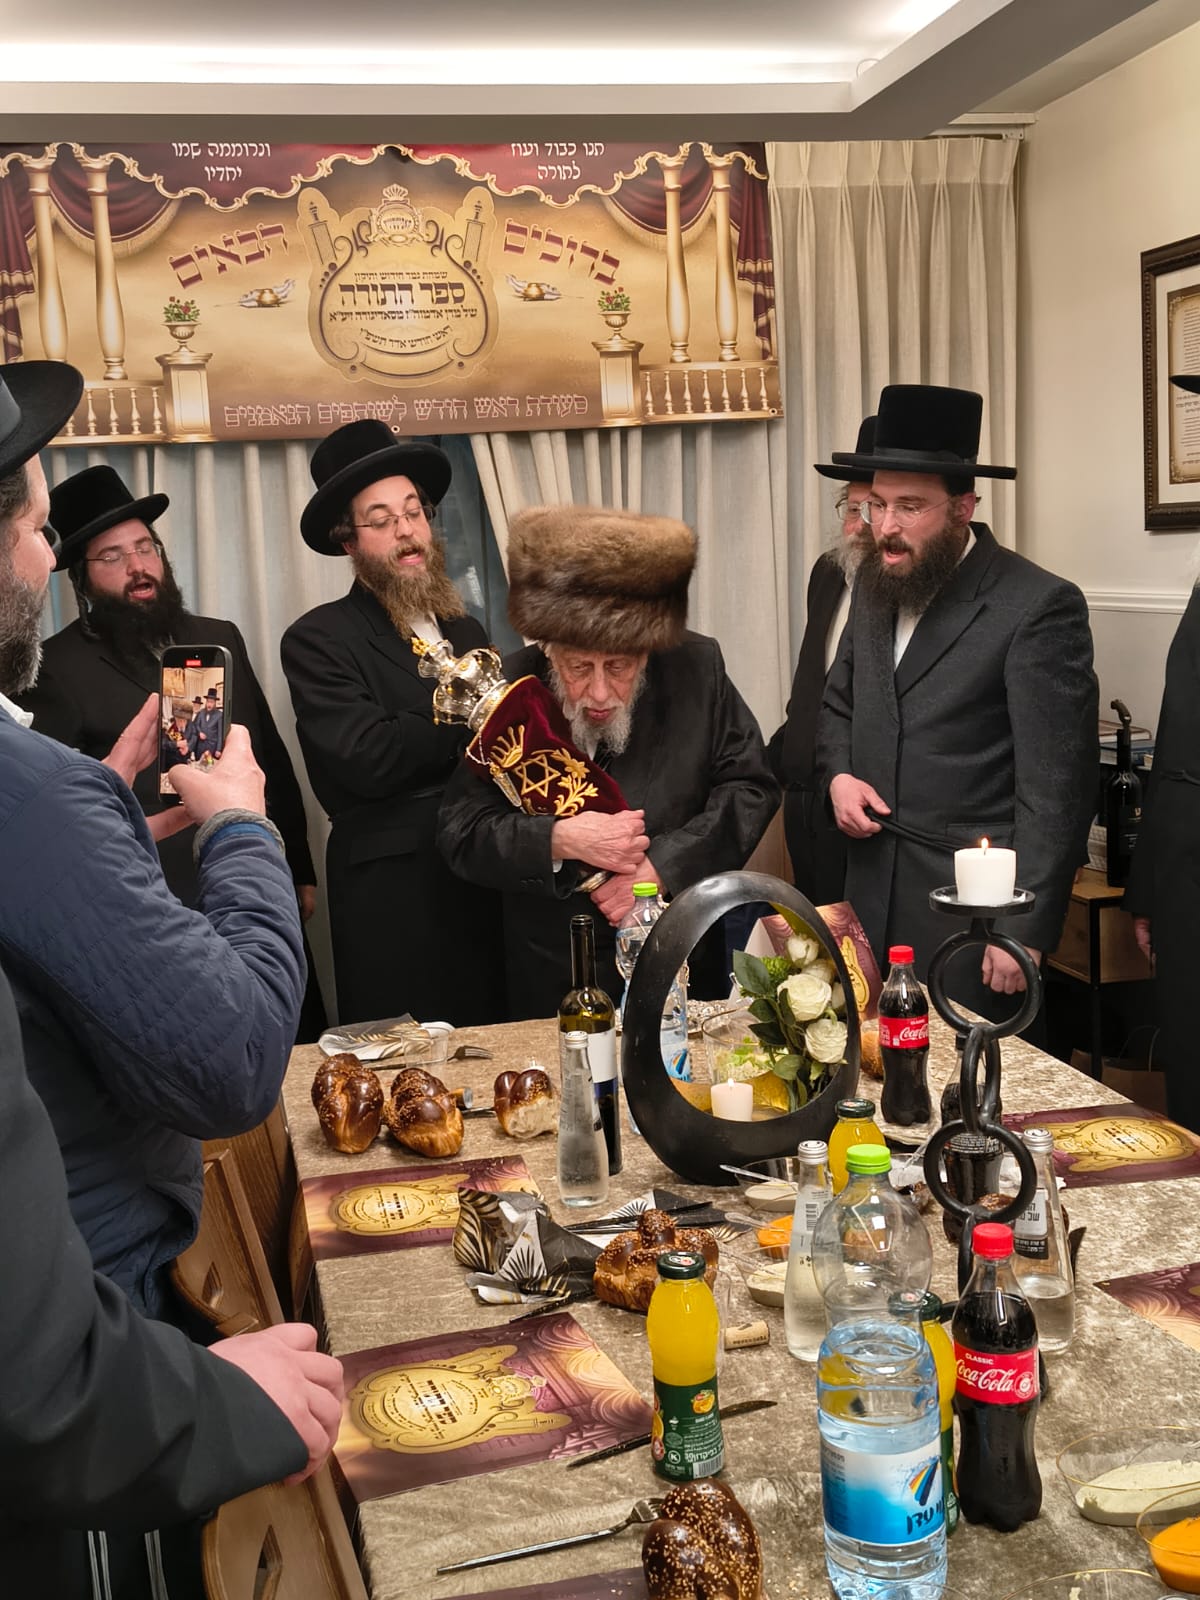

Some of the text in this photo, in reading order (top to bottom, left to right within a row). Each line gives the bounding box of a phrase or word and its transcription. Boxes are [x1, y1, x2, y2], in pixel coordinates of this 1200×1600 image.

[208, 143, 271, 157] ונרוממה
[511, 142, 605, 157] תנו כבוד ועוז
[204, 166, 242, 182] יחדיו
[537, 160, 581, 180] לתורה
[169, 223, 288, 289] הבאים
[503, 218, 620, 285] ברוכים
[340, 282, 465, 306] ספר התורה
[223, 394, 588, 428] סעודת ראש חודש לשותפים הנאמנים
[965, 1352, 995, 1366] CLASSIC
[956, 1359, 1018, 1393] Coca-Cola
